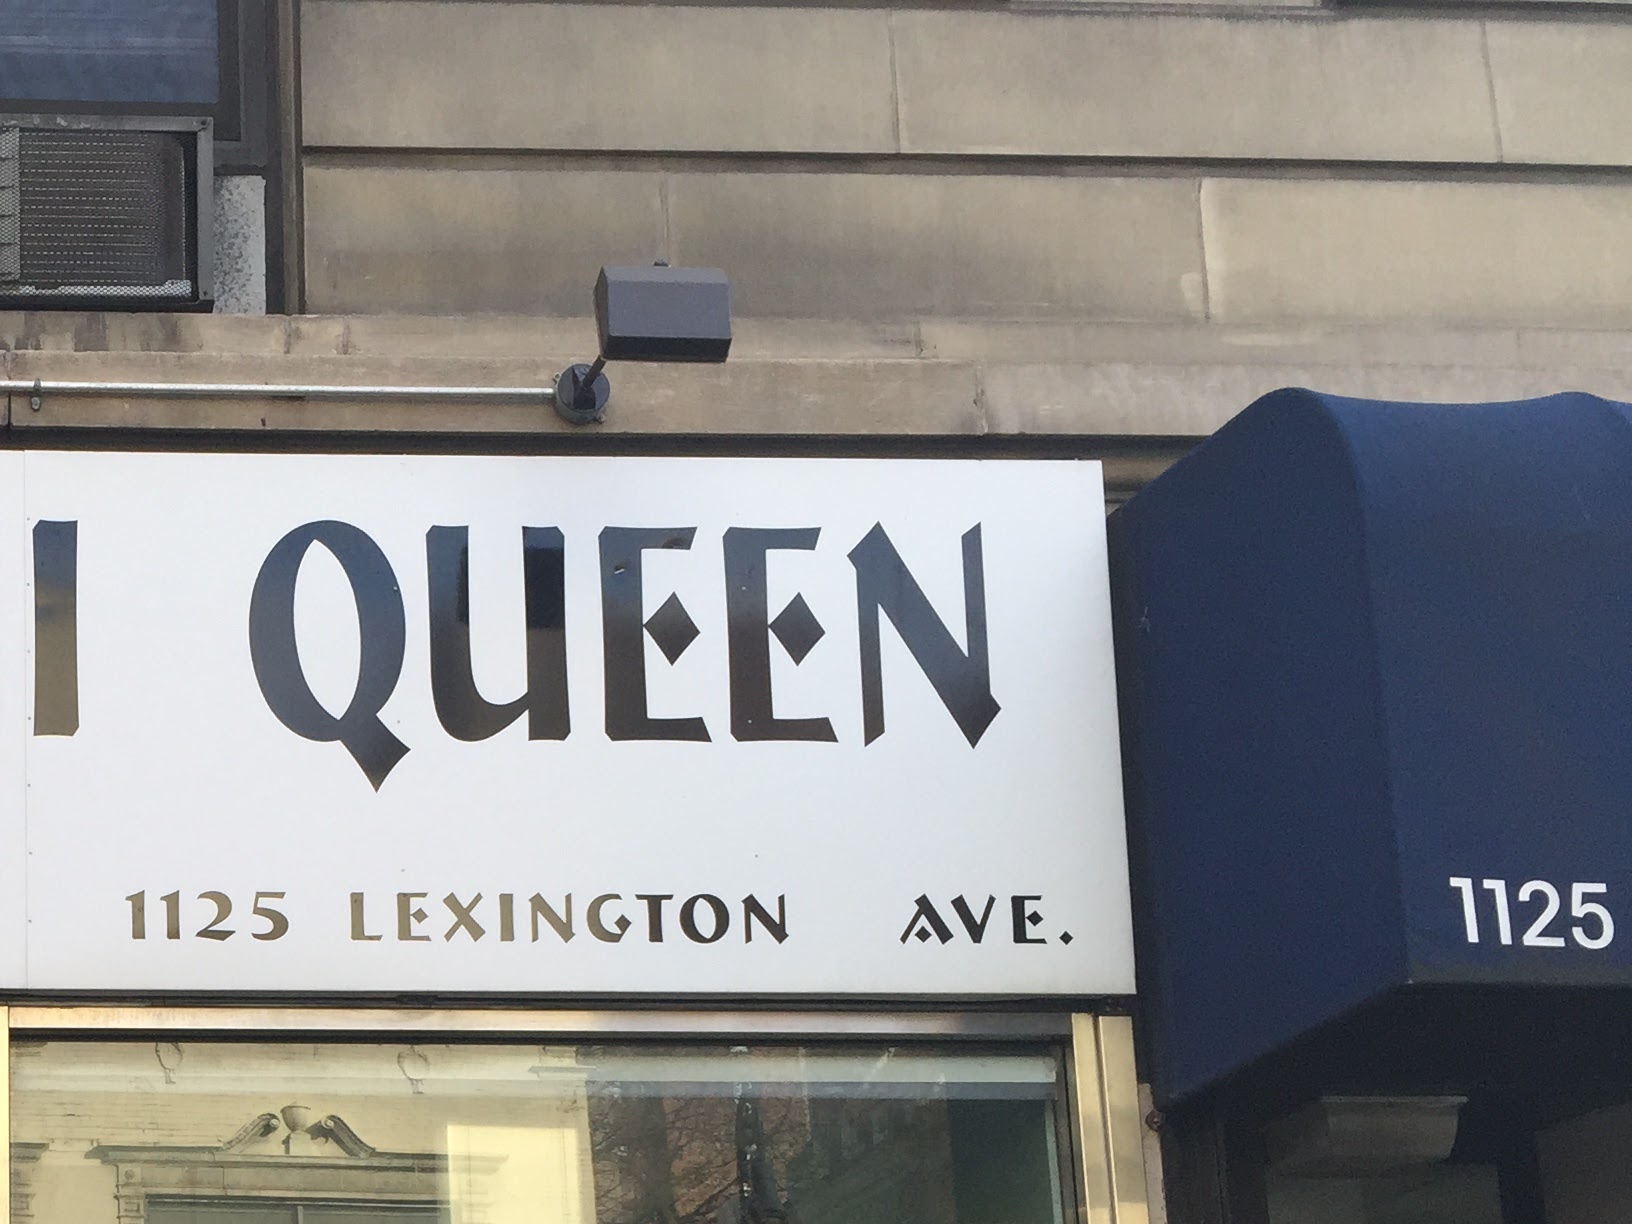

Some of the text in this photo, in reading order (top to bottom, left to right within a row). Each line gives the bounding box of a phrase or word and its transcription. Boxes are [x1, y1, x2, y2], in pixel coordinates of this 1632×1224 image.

[248, 519, 1001, 792] QUEEN
[124, 889, 1074, 946] 1125 LEXINGTON AVE.
[1449, 876, 1616, 950] 1125
